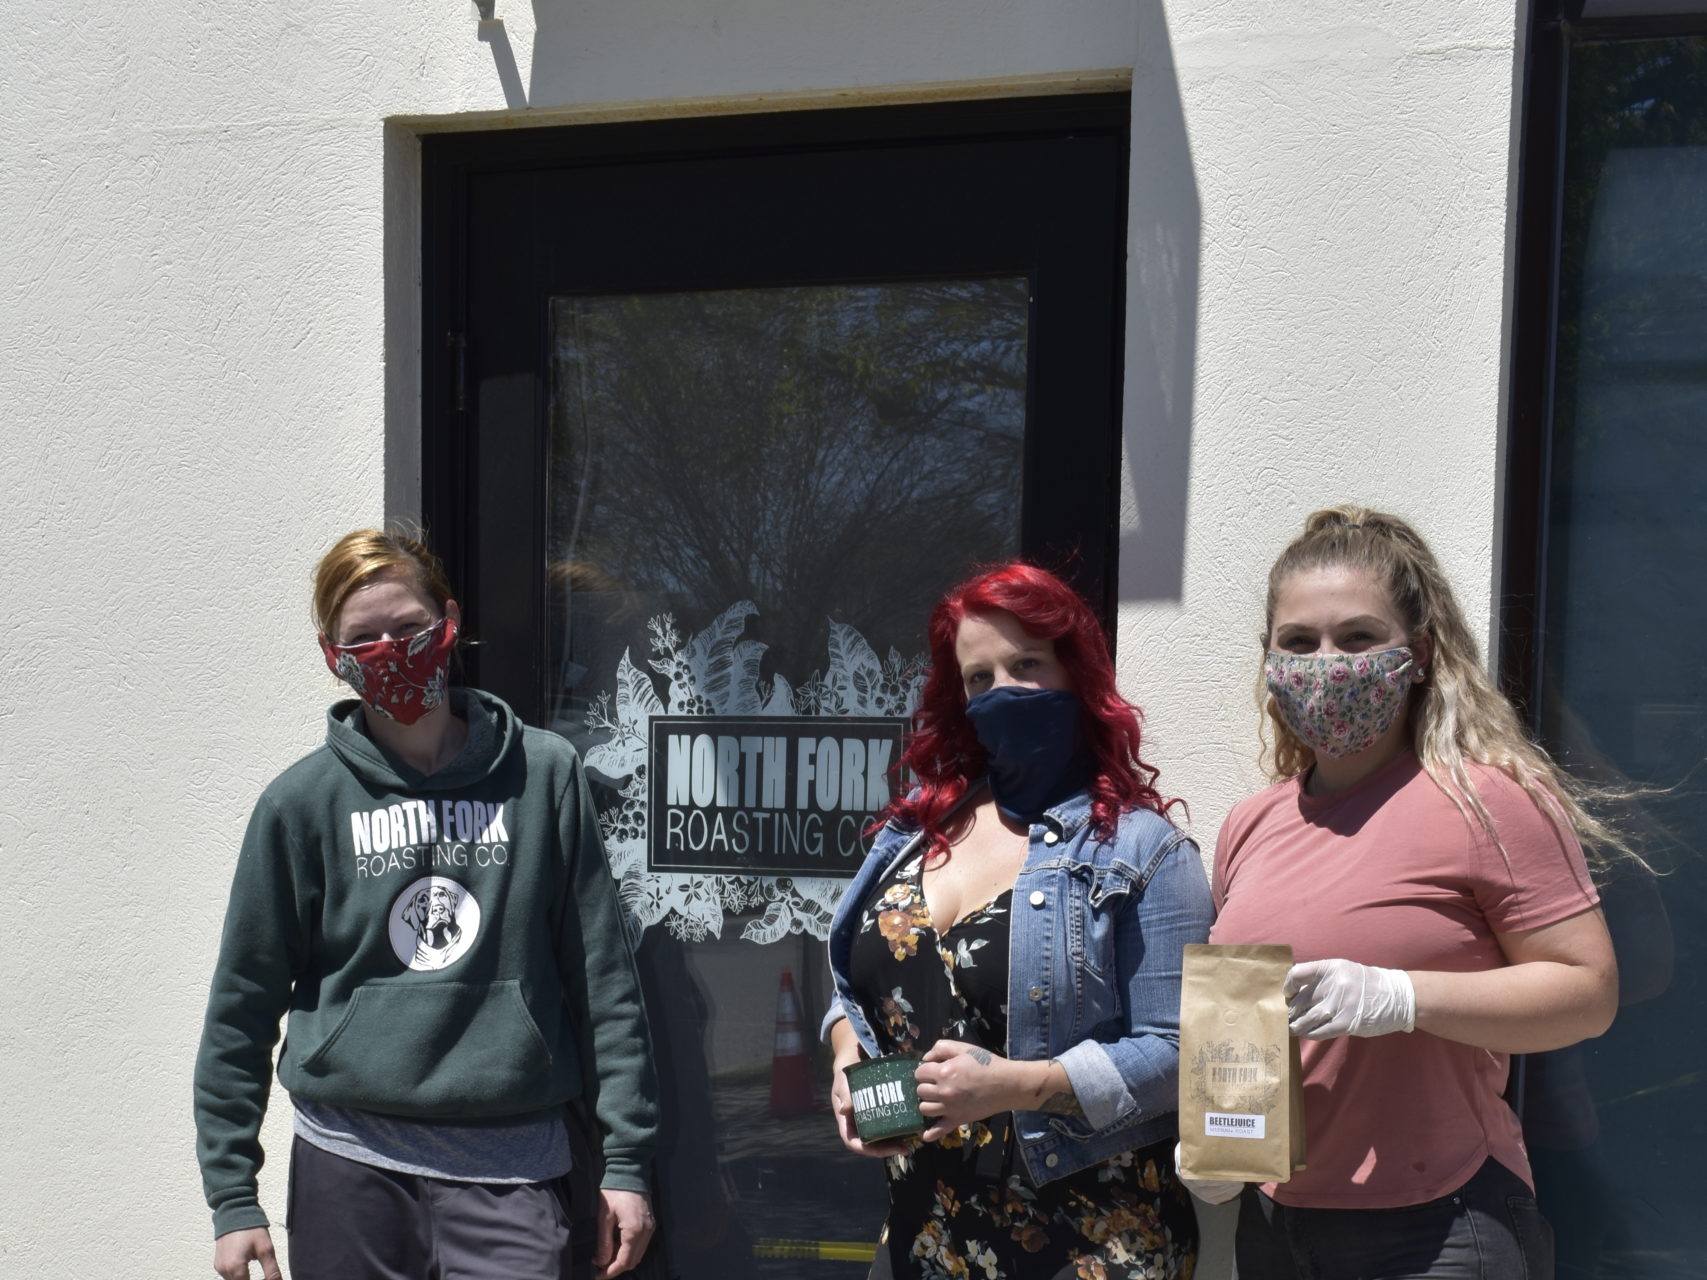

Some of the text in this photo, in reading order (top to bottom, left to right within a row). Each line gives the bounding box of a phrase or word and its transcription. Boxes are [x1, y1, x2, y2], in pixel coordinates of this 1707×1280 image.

[667, 734, 893, 812] NORTH FORK
[351, 799, 510, 856] NORTH FORK
[666, 808, 824, 858] ROASTING
[356, 844, 468, 880] ROASTING
[875, 1080, 905, 1106] FORK
[1209, 1116, 1256, 1128] BEETLEJUICE
